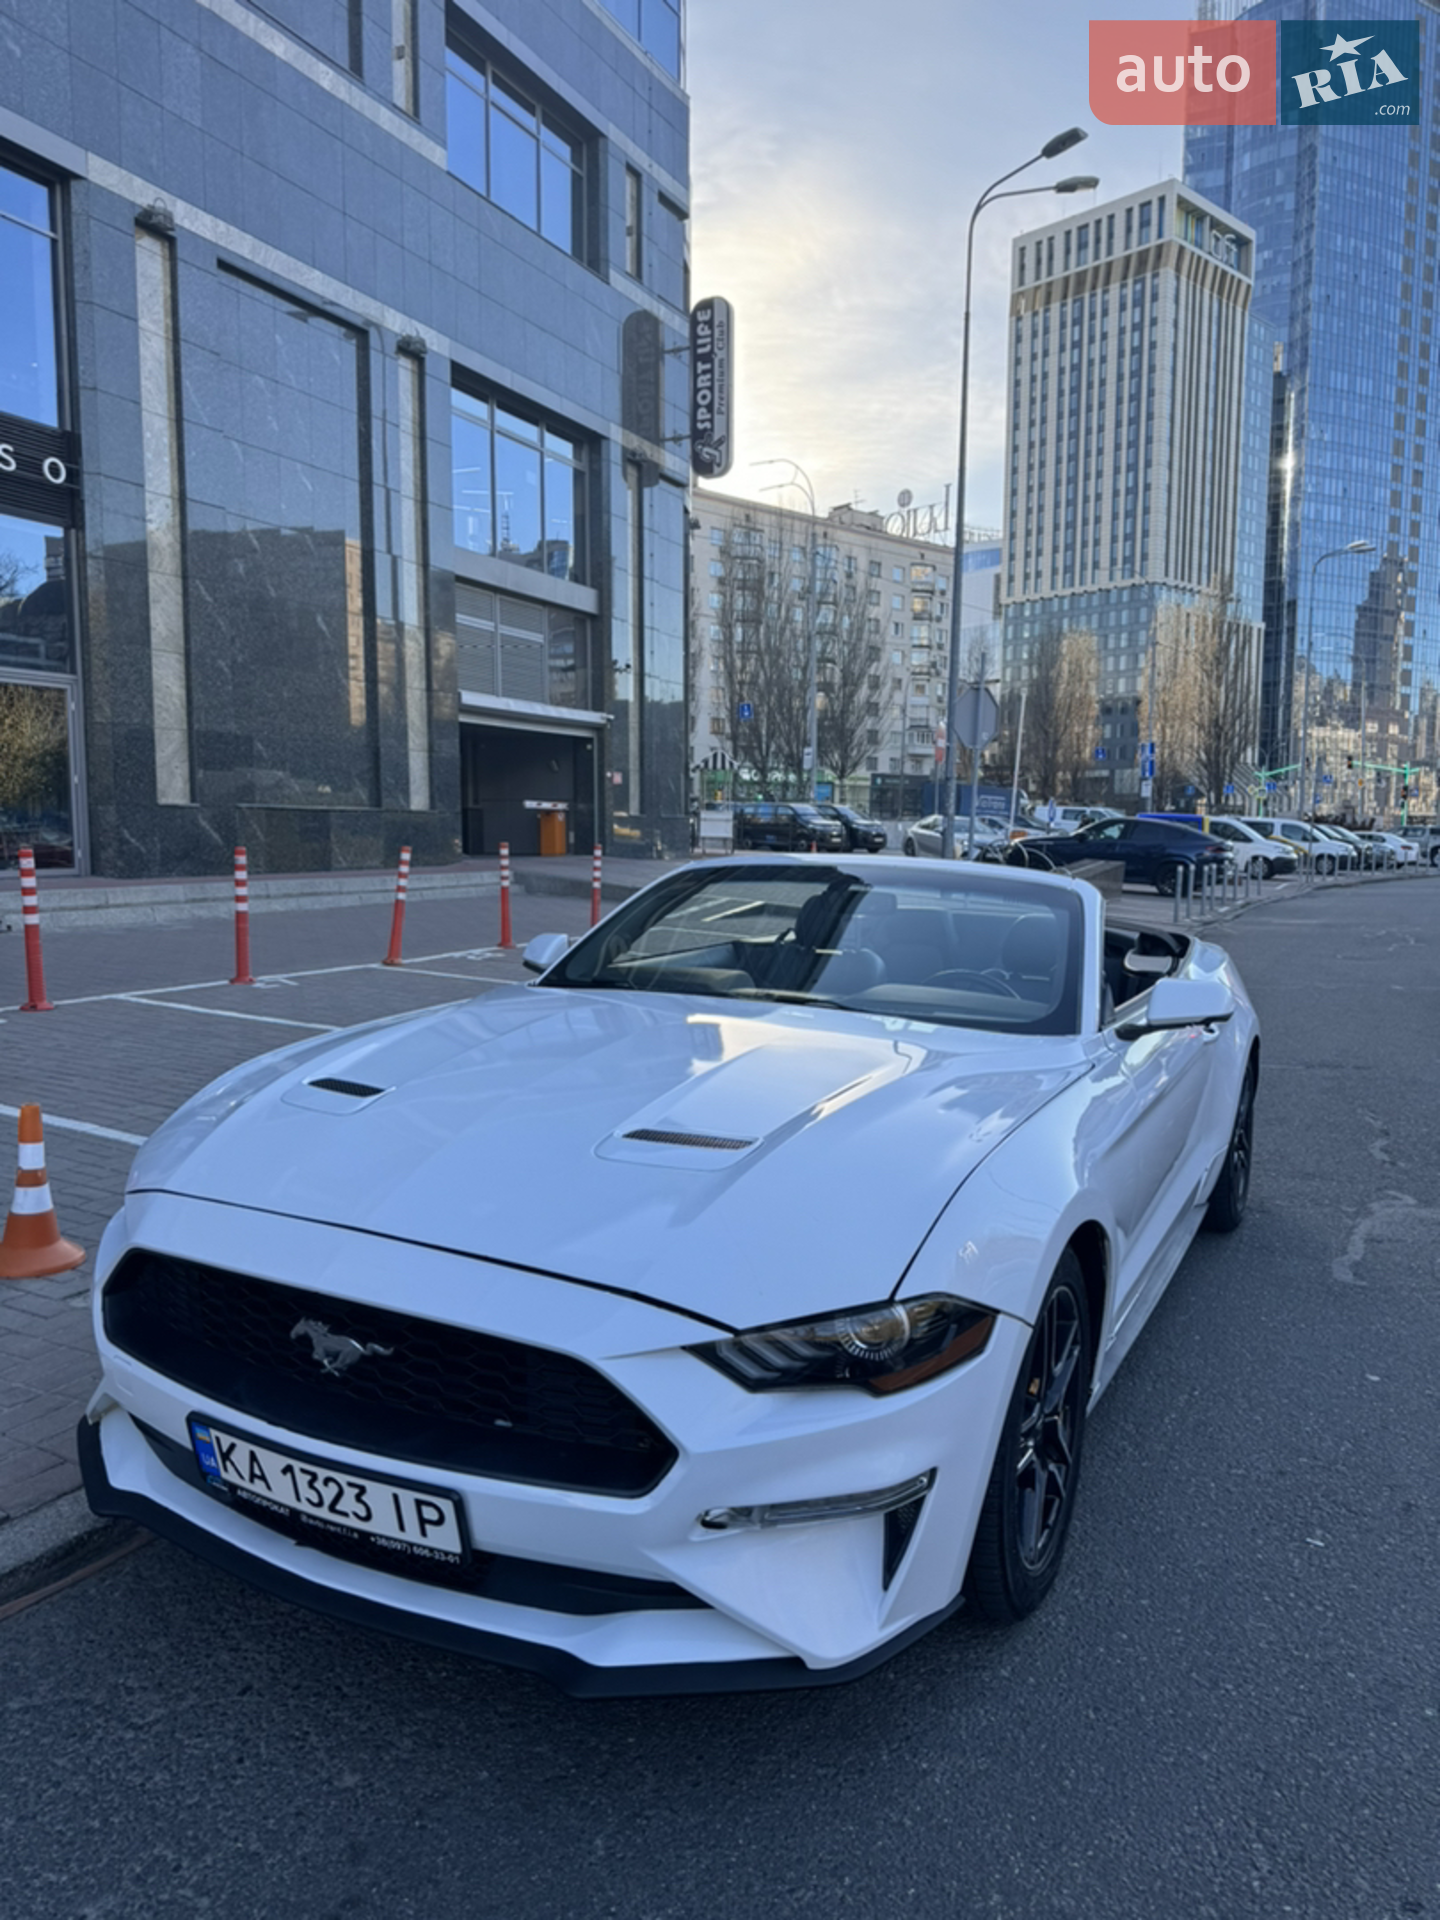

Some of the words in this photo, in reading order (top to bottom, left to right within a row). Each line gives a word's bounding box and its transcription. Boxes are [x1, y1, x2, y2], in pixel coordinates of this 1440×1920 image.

[696, 308, 712, 354] LIFE
[716, 320, 725, 351] Club
[696, 361, 712, 430] SPORT
[716, 357, 725, 416] Premium
[202, 1452, 217, 1468] UA
[215, 1436, 273, 1491] KA
[281, 1464, 372, 1522] 1323
[392, 1492, 446, 1538] IP
